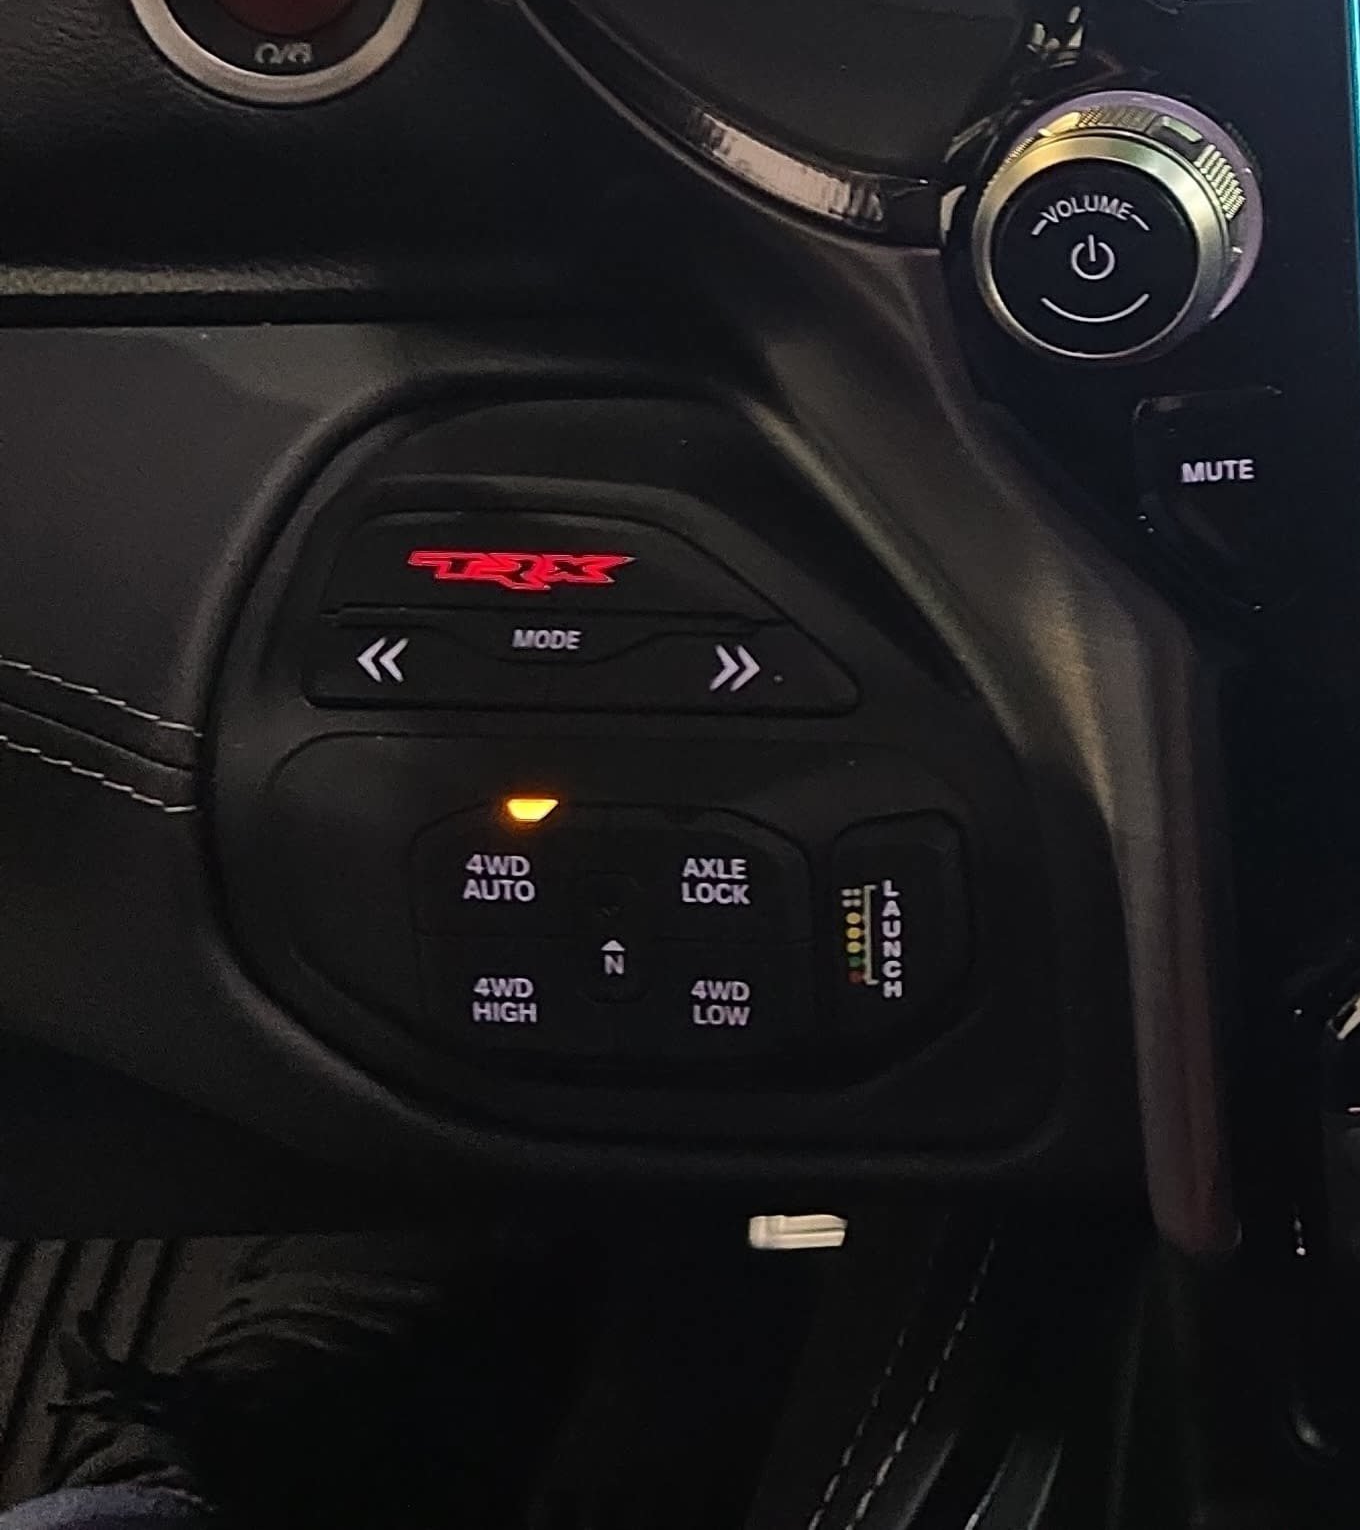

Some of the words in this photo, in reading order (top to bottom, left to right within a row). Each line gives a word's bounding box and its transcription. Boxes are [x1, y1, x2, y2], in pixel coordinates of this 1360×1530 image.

[1041, 195, 1134, 224] VOLUME
[1181, 458, 1256, 484] MUTE
[512, 629, 582, 651] MODE
[465, 854, 531, 878] 4WD
[682, 858, 748, 881] AXLE
[462, 878, 536, 903] AUTO
[681, 882, 751, 905] LOCK
[881, 879, 903, 999] LAUNCH
[604, 954, 626, 976] N
[473, 977, 534, 1000] 4WD
[691, 980, 751, 1003] 4WD
[472, 1001, 538, 1024] HIGH
[693, 1004, 751, 1027] LOW
